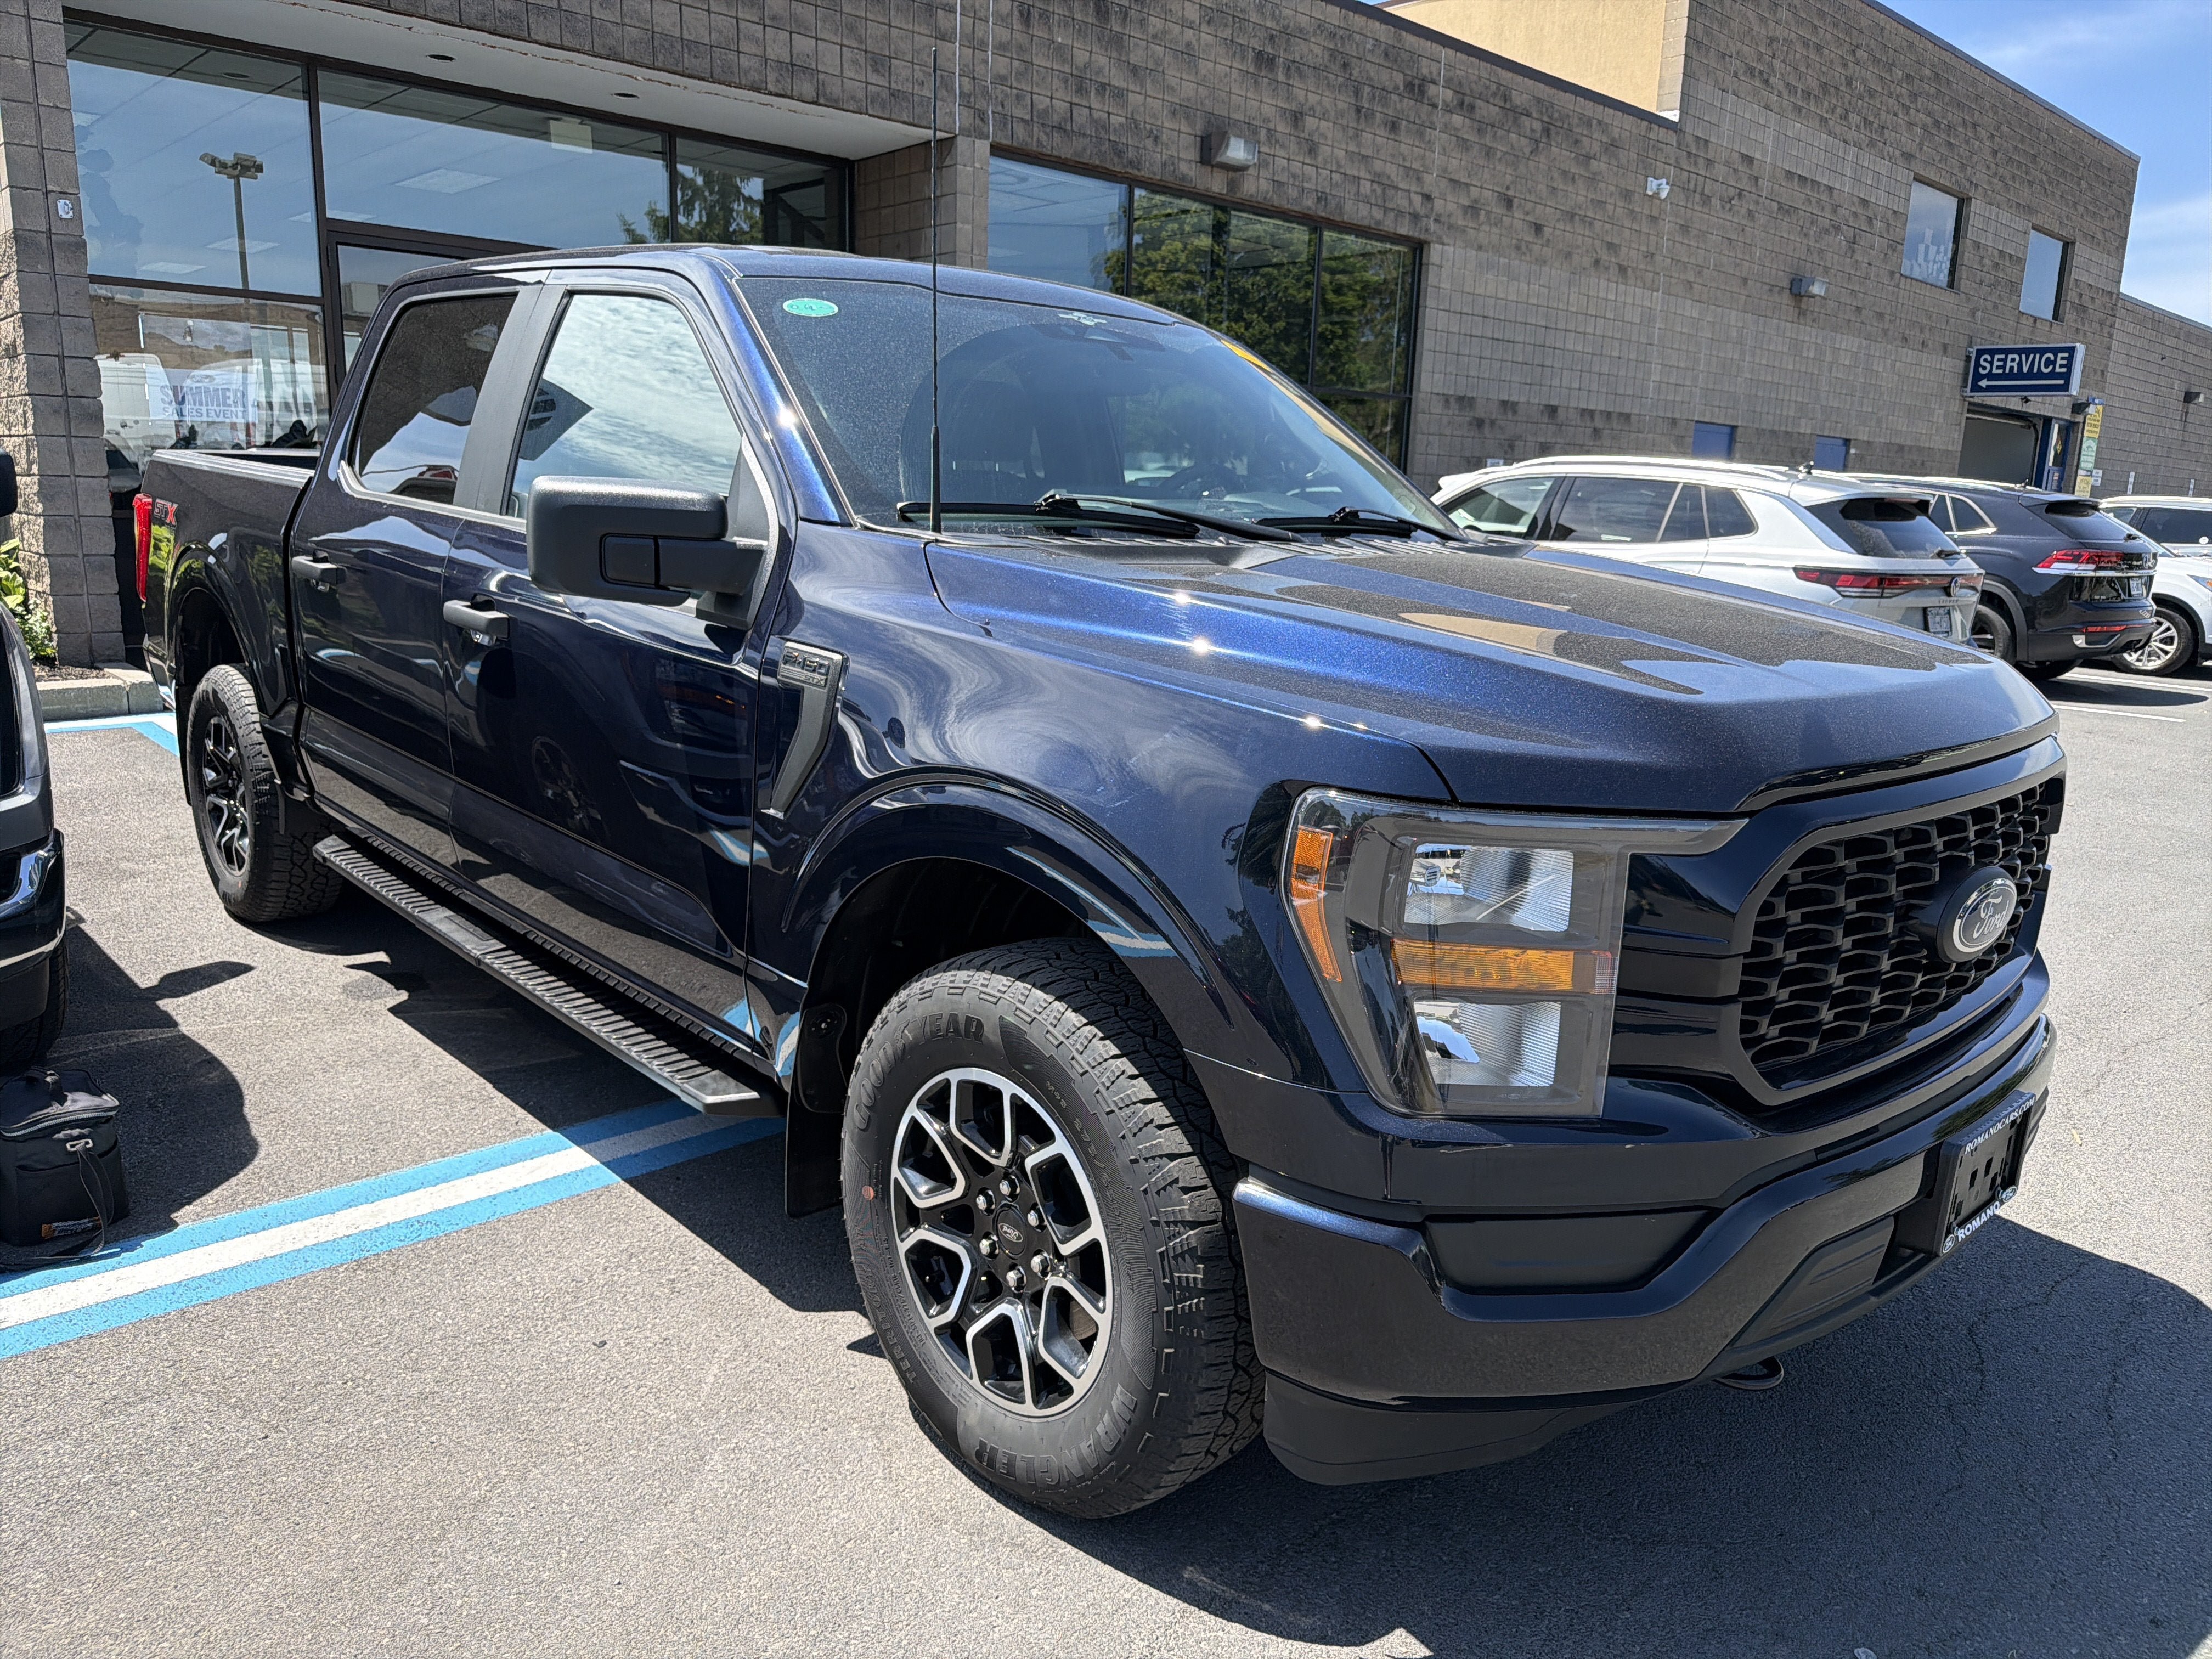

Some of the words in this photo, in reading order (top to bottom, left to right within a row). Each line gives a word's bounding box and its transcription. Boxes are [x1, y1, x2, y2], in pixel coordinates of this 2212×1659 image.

[1978, 352, 2069, 374] SERVICE
[160, 385, 247, 408] SUMMER
[162, 407, 202, 417] SALES
[206, 409, 247, 419] EVENT
[154, 499, 179, 525] STX
[804, 675, 825, 686] STX
[1973, 895, 2010, 939] Ford
[1965, 1096, 2035, 1155] ROMANOCARS.COM
[1002, 1225, 1019, 1241] Ford
[1957, 1201, 2001, 1242] ROMANO
[974, 1383, 1137, 1485] WRANGLER
